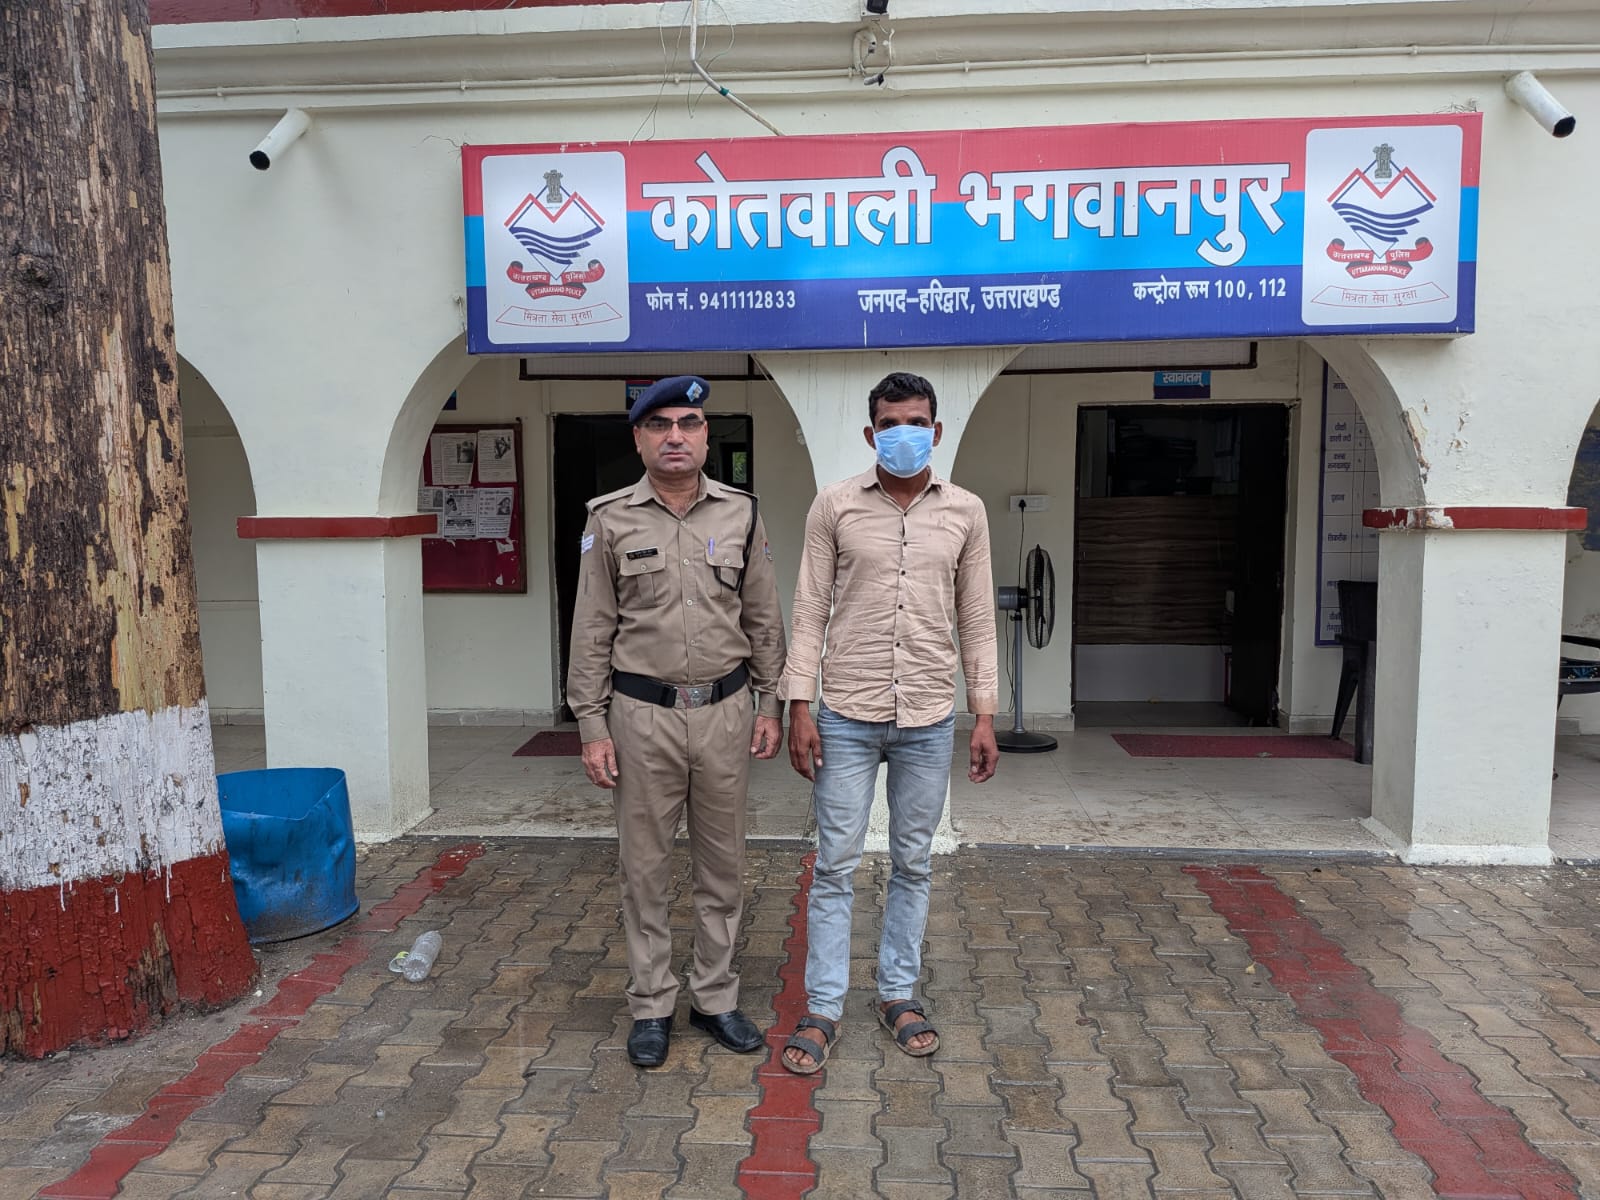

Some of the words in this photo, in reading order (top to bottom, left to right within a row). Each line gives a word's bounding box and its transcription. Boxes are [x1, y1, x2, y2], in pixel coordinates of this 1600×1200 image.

[641, 145, 937, 250] कोतवाली
[959, 163, 1291, 267] भगवानपुर
[1390, 250, 1410, 261] पुलिस
[1351, 265, 1389, 276] UTTARAKHAND
[1389, 265, 1408, 276] POLICE
[531, 286, 565, 297] UTTARAKHAND
[565, 287, 582, 297] POLICE
[981, 284, 1061, 310] उत्तराखण्ड
[1133, 274, 1181, 304] कन्ट्रोल
[1184, 280, 1209, 299] रूम
[1259, 278, 1287, 297] 112
[645, 286, 673, 311] फोन
[677, 287, 694, 310] नं.
[699, 290, 796, 310] 9411112833
[1372, 291, 1388, 304] सेवा
[1393, 289, 1417, 306] सुरक्षा
[551, 311, 567, 323] सेवा
[571, 310, 593, 325] सुरक्षा
[1162, 372, 1204, 387] स्वागतम्
